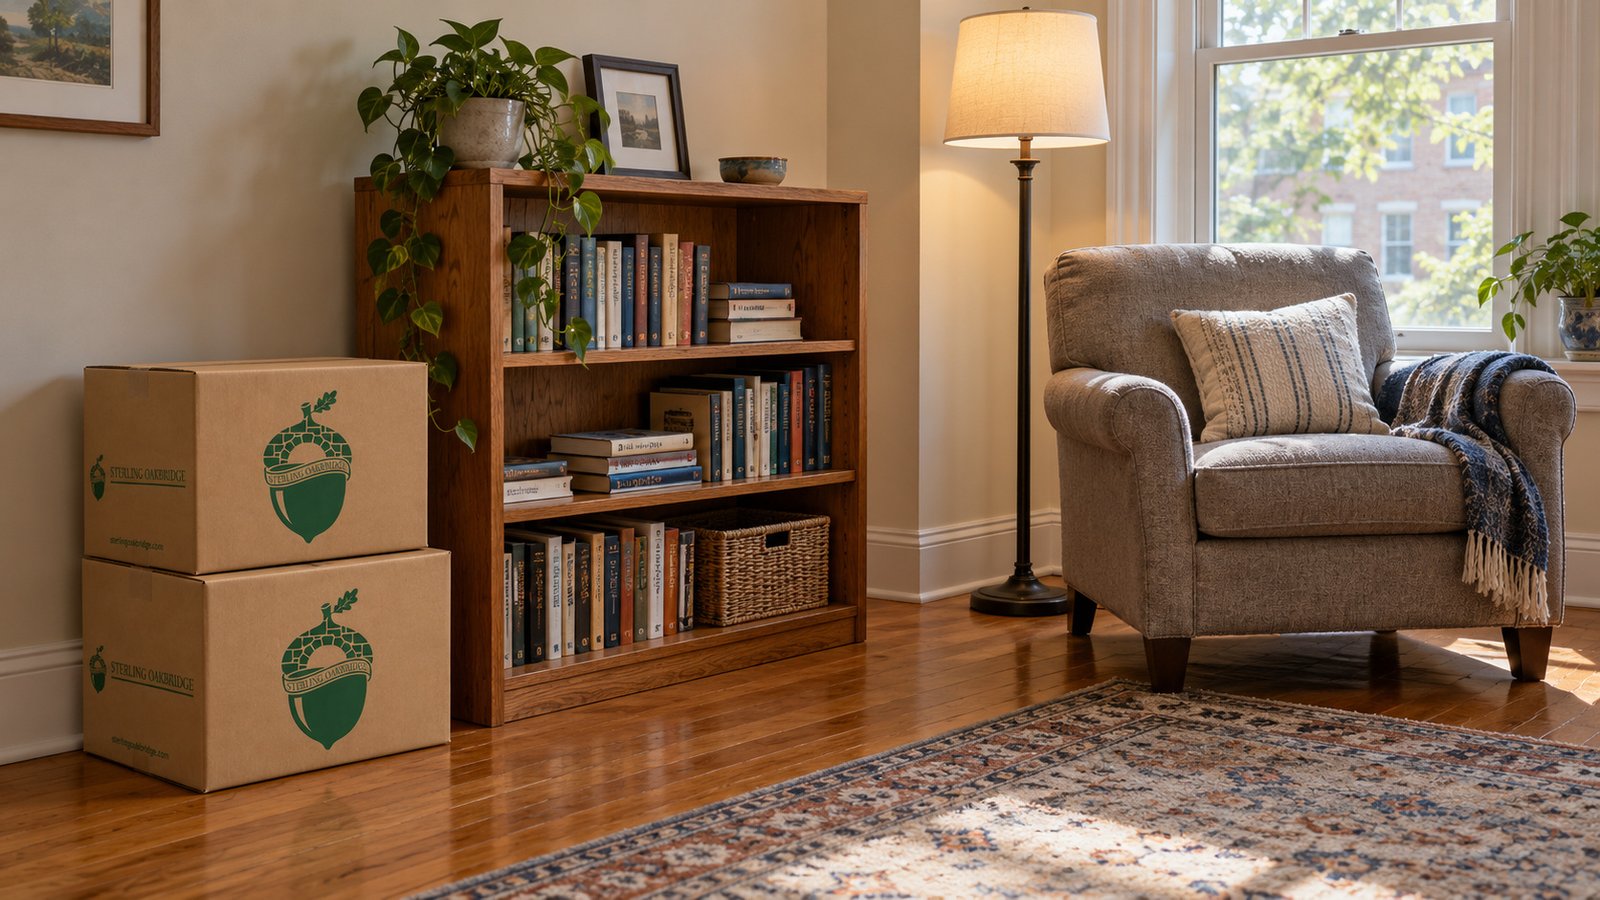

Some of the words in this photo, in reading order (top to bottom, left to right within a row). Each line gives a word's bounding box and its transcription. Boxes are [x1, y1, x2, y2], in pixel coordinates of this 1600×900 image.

[110, 466, 143, 480] STERLING
[144, 468, 186, 482] OAKBRIDGE
[111, 661, 147, 681] STERLING
[148, 669, 194, 691] OAKBRIDGE
